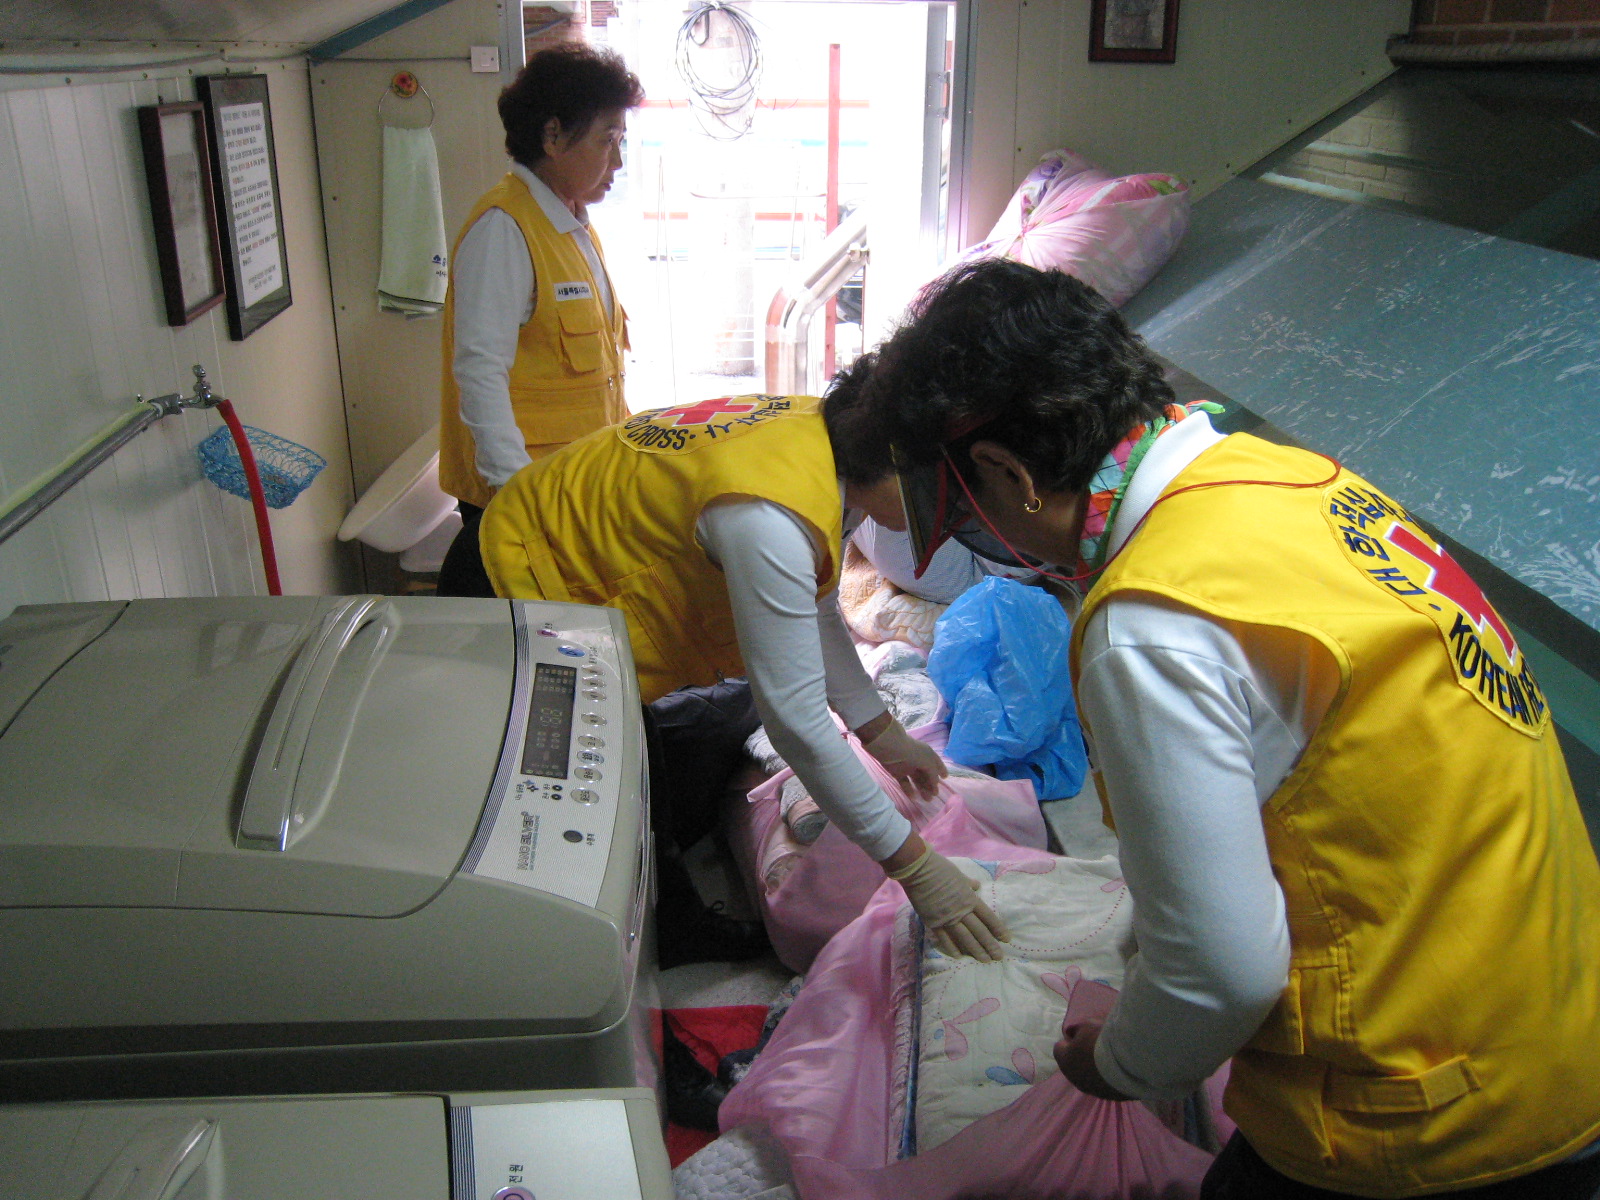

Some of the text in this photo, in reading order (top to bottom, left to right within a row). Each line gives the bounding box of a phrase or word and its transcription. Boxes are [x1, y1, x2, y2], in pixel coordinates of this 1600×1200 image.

[627, 424, 689, 450] CROSS
[1449, 612, 1533, 726] KOREAN
[517, 846, 530, 871] NANO
[509, 1164, 524, 1183] 전원
